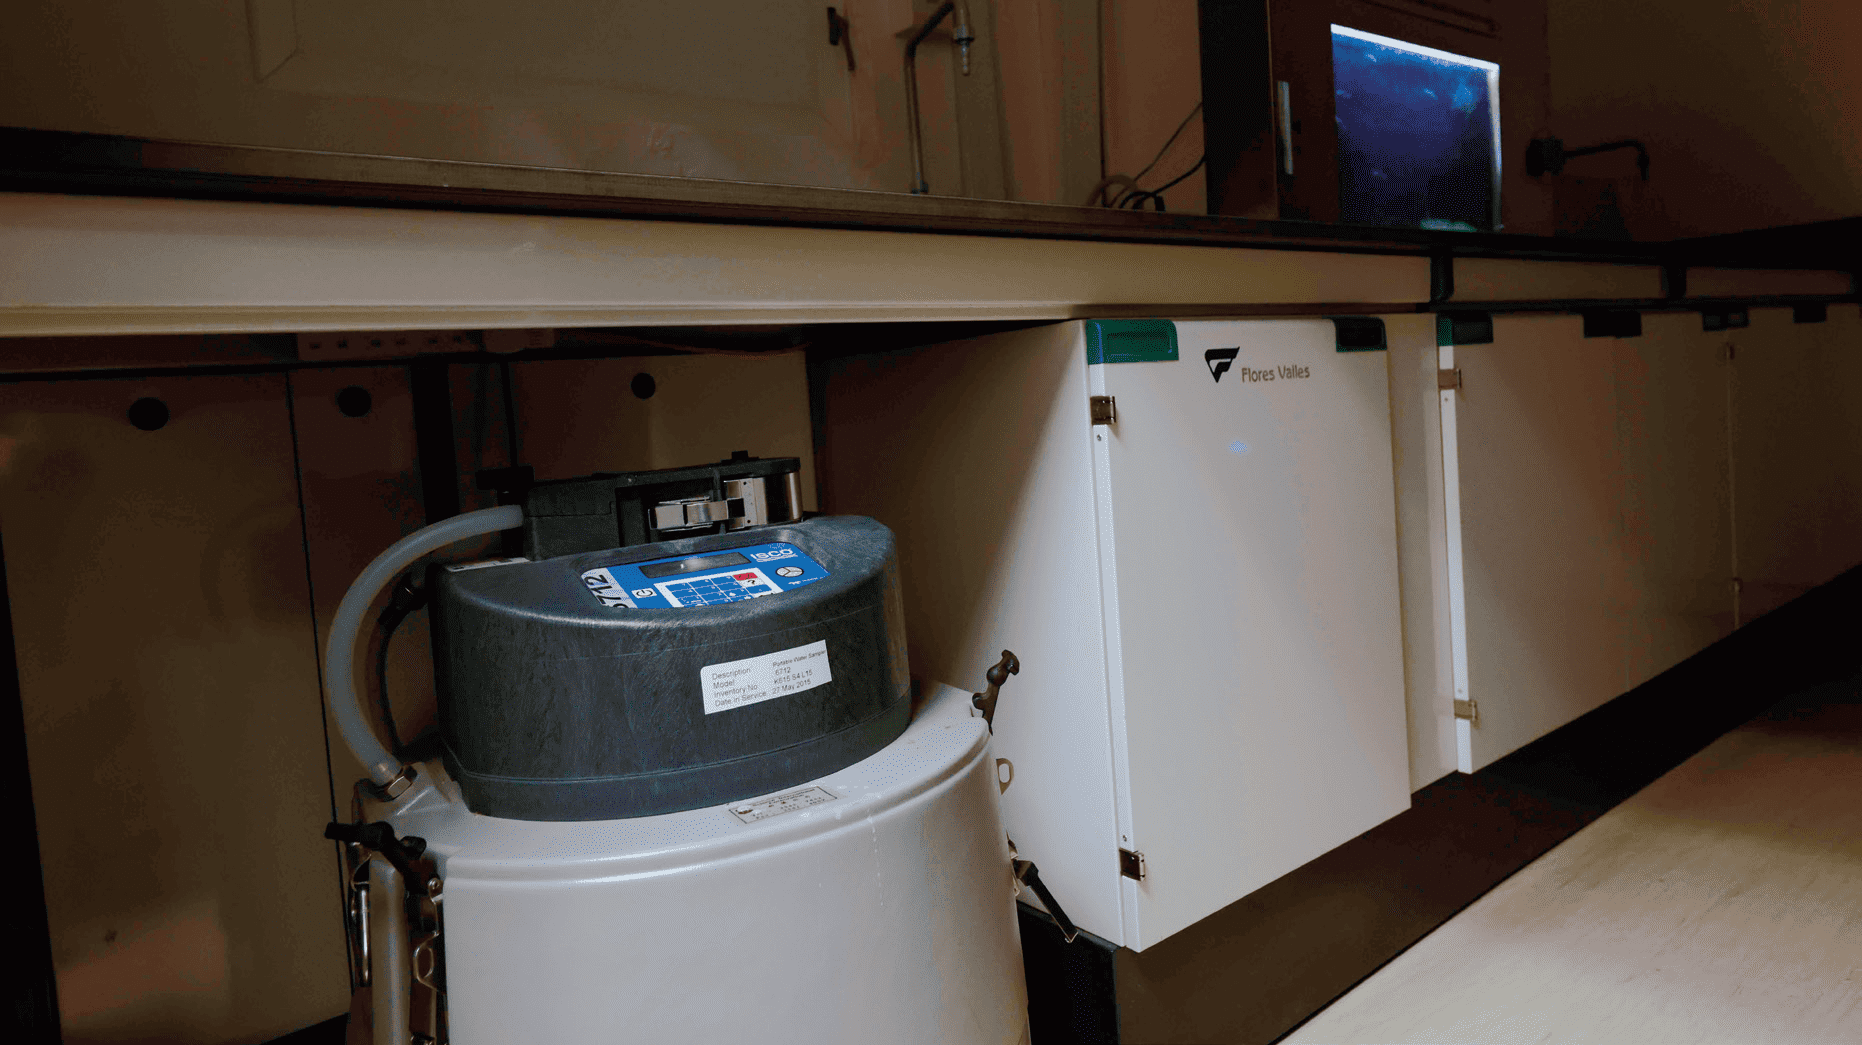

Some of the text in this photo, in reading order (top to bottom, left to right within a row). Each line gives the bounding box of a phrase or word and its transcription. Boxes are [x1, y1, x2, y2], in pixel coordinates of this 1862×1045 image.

[1241, 365, 1310, 383] Flores Valles
[750, 548, 794, 560] ISCO
[712, 667, 750, 681] Description
[775, 667, 791, 676] 6712
[801, 669, 813, 678] L15
[713, 679, 735, 690] Model
[714, 683, 758, 698] Inventory No
[772, 679, 812, 695] 27 May 2015
[715, 697, 732, 707] Date
[742, 691, 767, 702] Service
